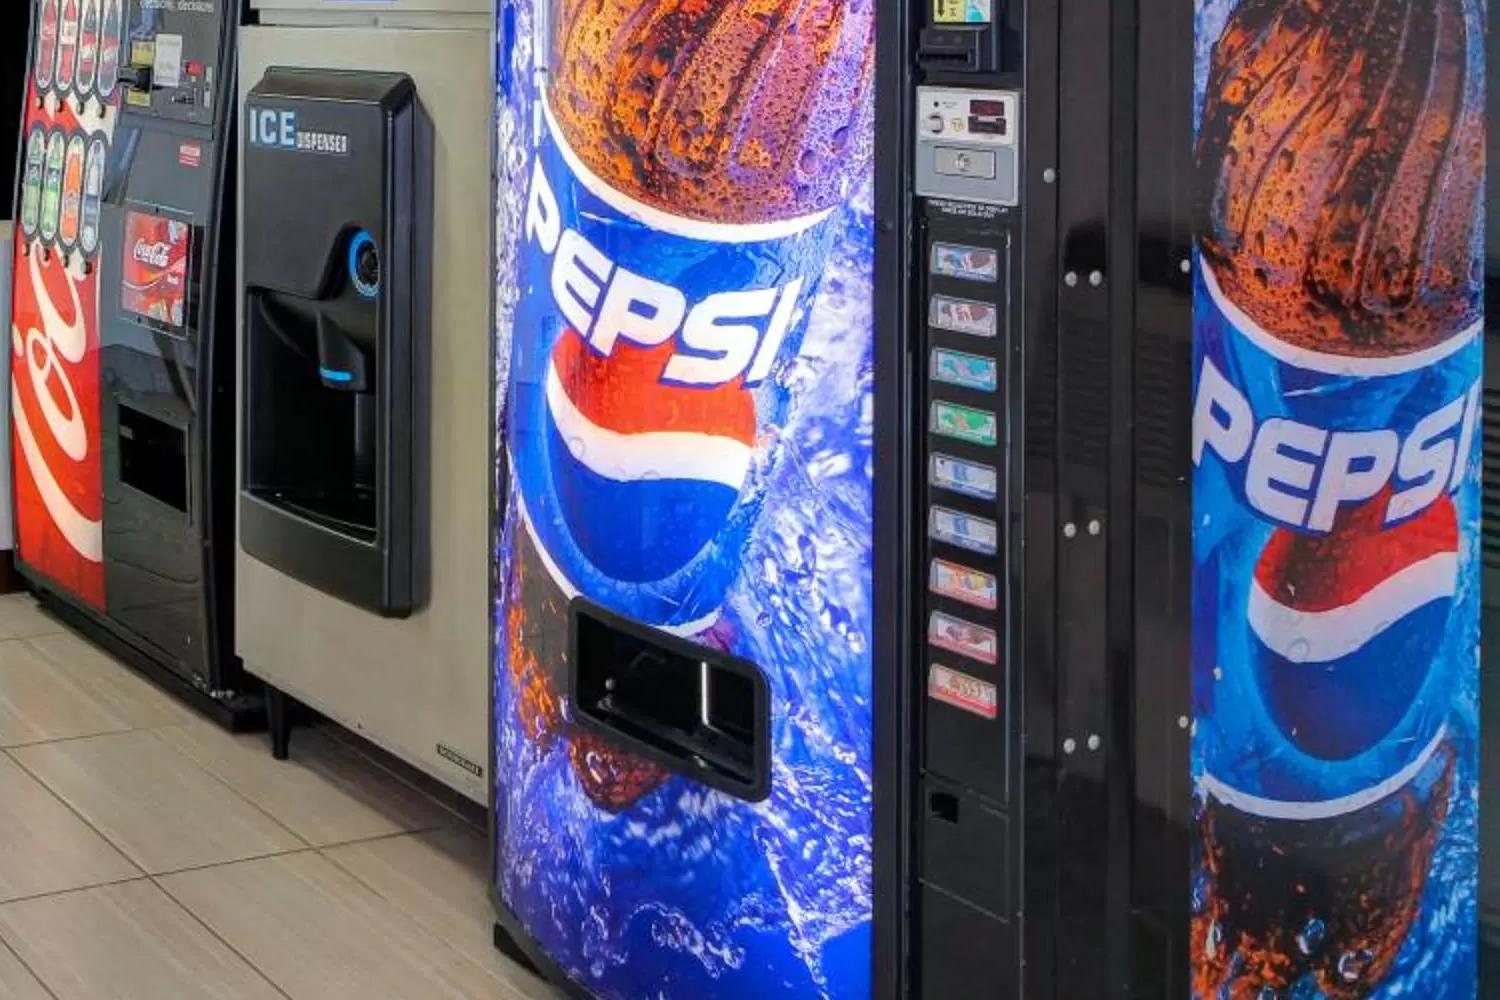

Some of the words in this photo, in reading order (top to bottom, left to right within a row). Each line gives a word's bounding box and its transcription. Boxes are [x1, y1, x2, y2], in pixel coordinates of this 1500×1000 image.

[249, 108, 296, 146] ICE
[524, 157, 804, 386] PEPSI
[1192, 354, 1482, 534] PEPSI
